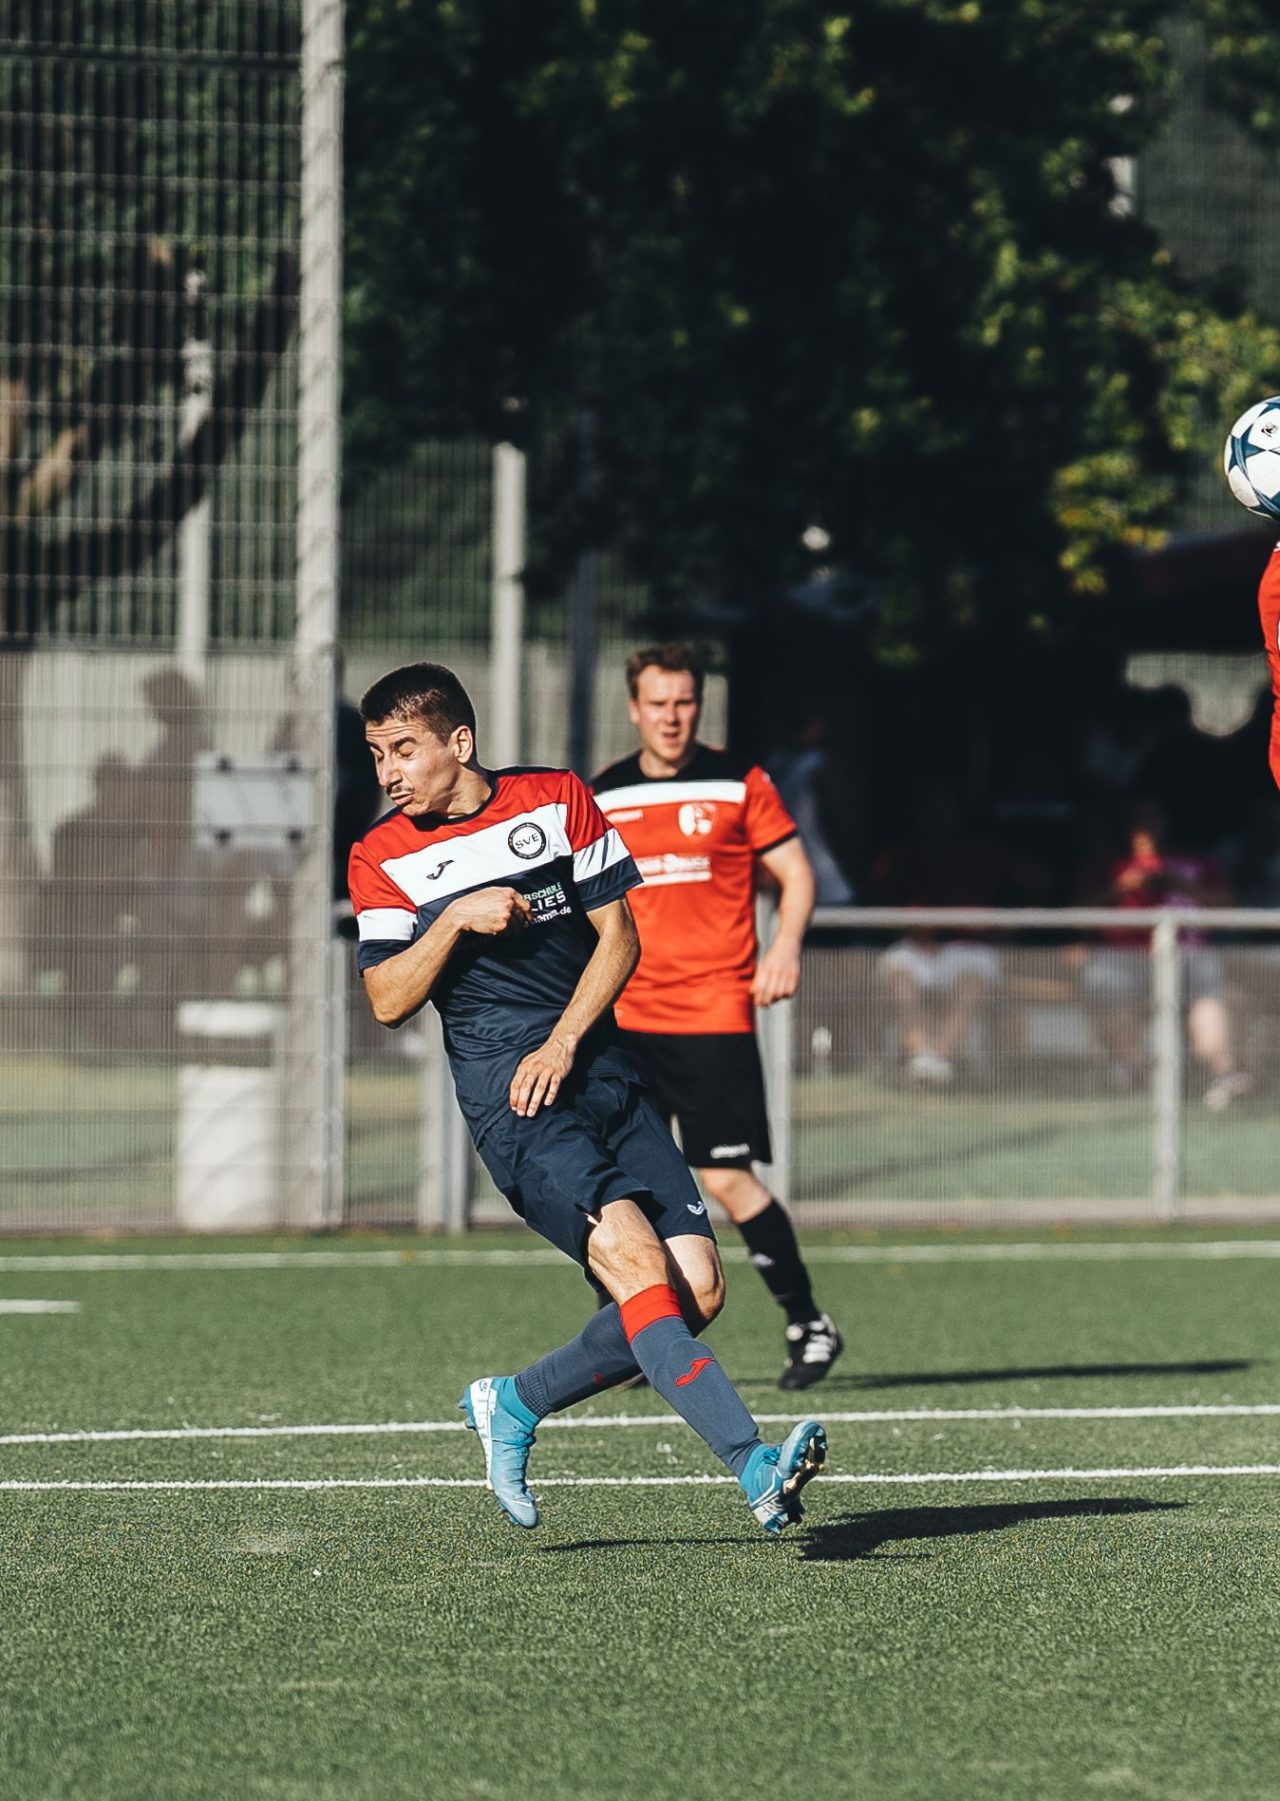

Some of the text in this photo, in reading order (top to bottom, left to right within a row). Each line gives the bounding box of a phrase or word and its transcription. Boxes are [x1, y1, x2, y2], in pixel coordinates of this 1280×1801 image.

[515, 832, 539, 849] SVE
[523, 881, 562, 901] RSCHULE
[531, 890, 566, 911] IES
